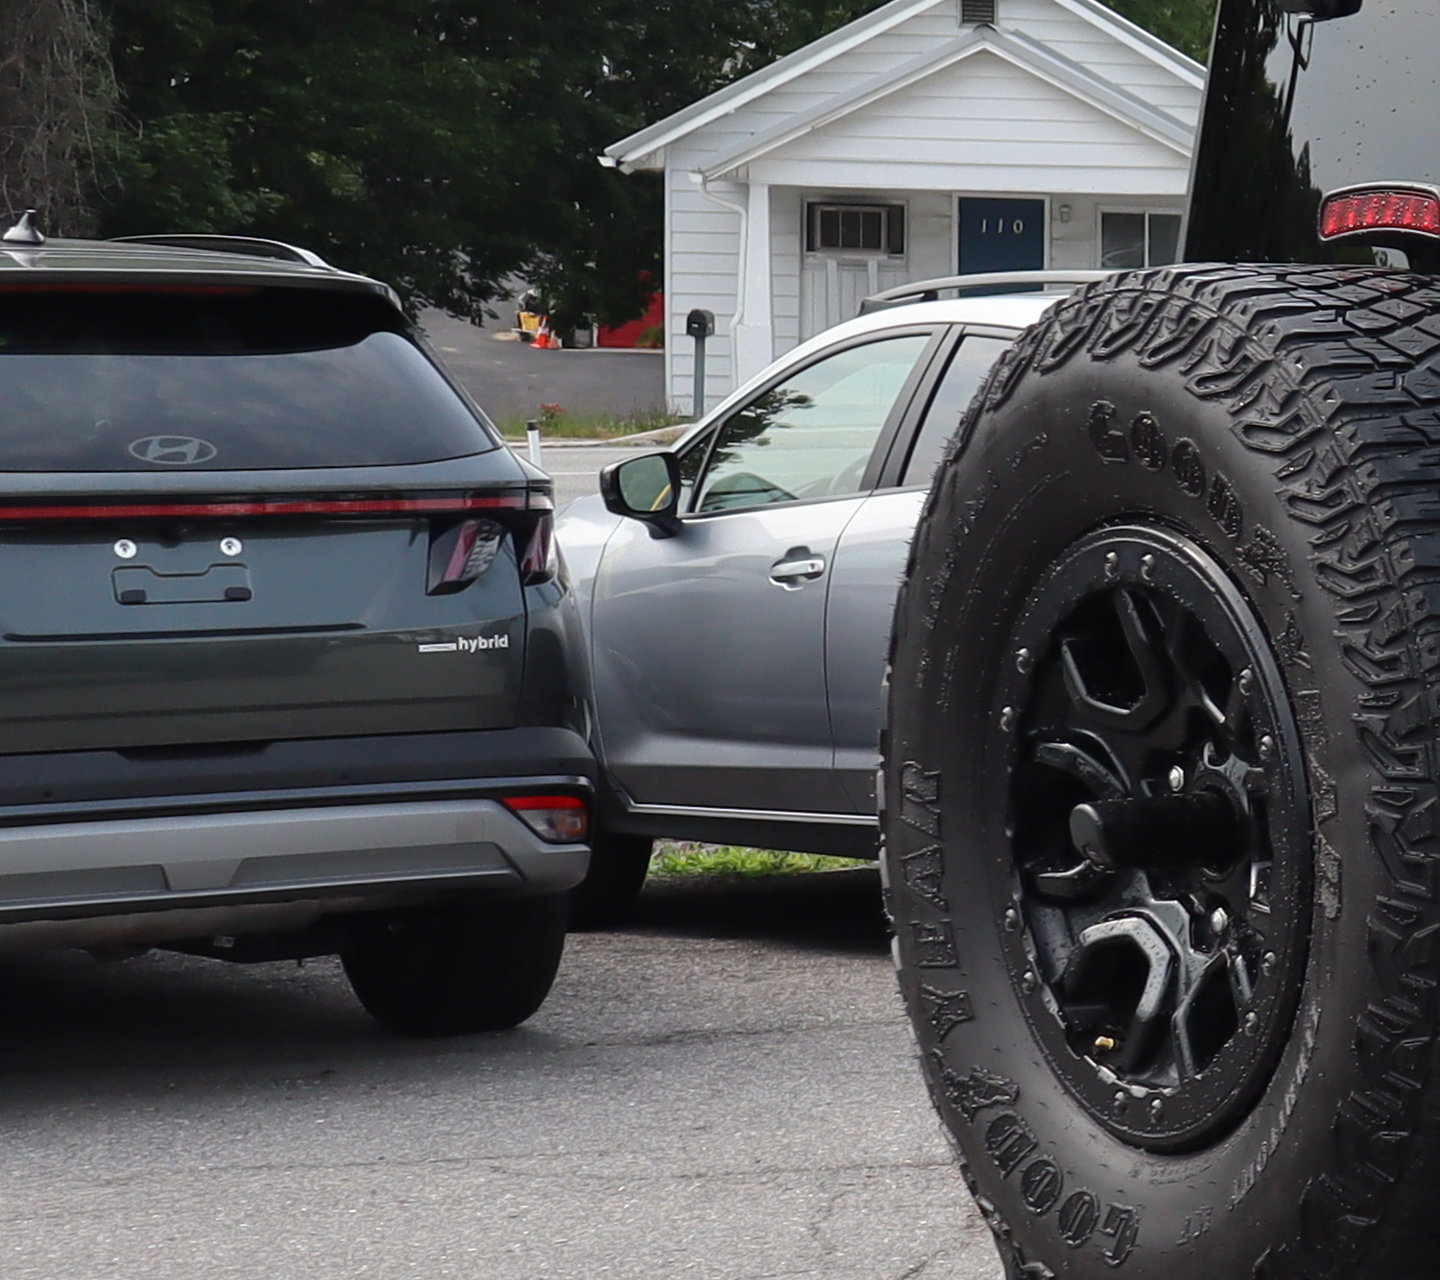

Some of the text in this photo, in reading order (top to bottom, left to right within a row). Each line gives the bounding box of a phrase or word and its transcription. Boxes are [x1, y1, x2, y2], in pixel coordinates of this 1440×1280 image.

[981, 218, 1023, 234] 110
[458, 634, 509, 653] hybrid
[899, 759, 1139, 1271] GOODYEAR
